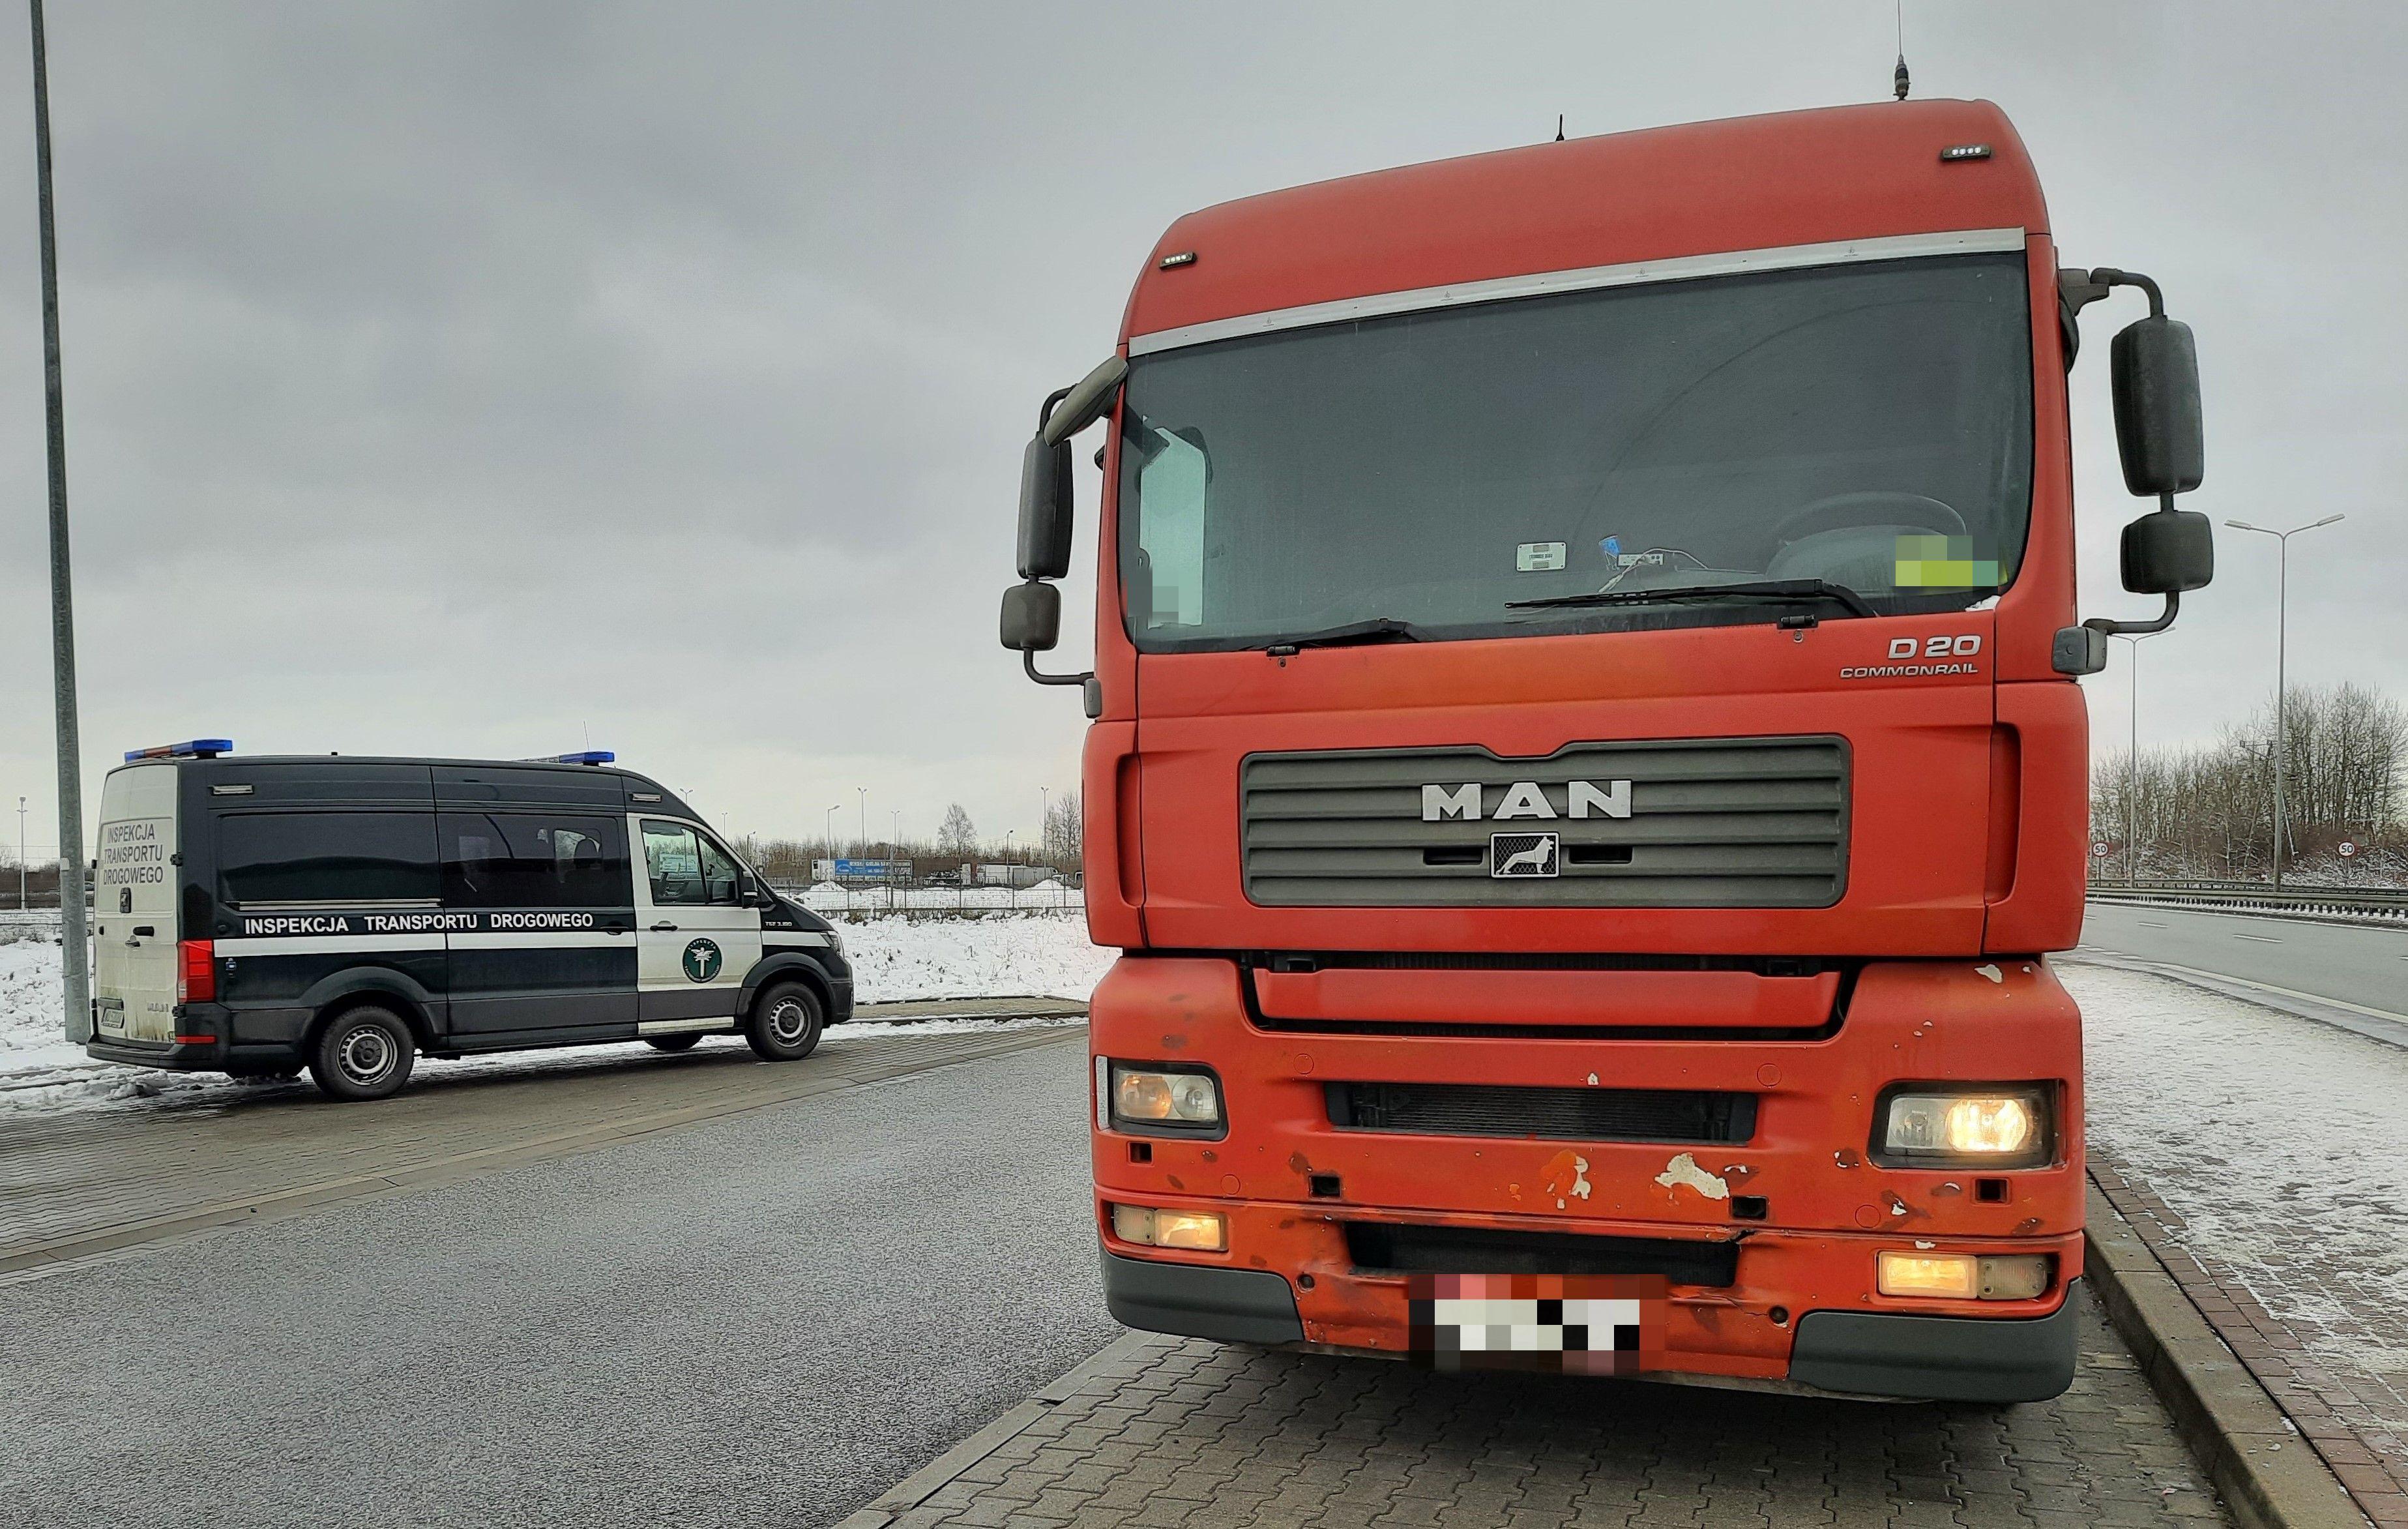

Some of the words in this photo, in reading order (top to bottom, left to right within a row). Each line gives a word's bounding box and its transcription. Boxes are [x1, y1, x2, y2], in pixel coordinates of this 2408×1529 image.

[1888, 638, 1918, 659] D
[1925, 635, 1981, 657] 20
[1840, 663, 1978, 678] COMMONRAIL
[1422, 780, 1632, 820] MAN
[108, 824, 155, 843] INSPEKCJA
[104, 844, 163, 864] TRANSPORTU
[104, 866, 163, 885] DROGOWEGO
[245, 917, 349, 934] INSPEKCJA
[364, 914, 477, 930] TRANSPORTU
[491, 913, 593, 928] DROGOWEGO
